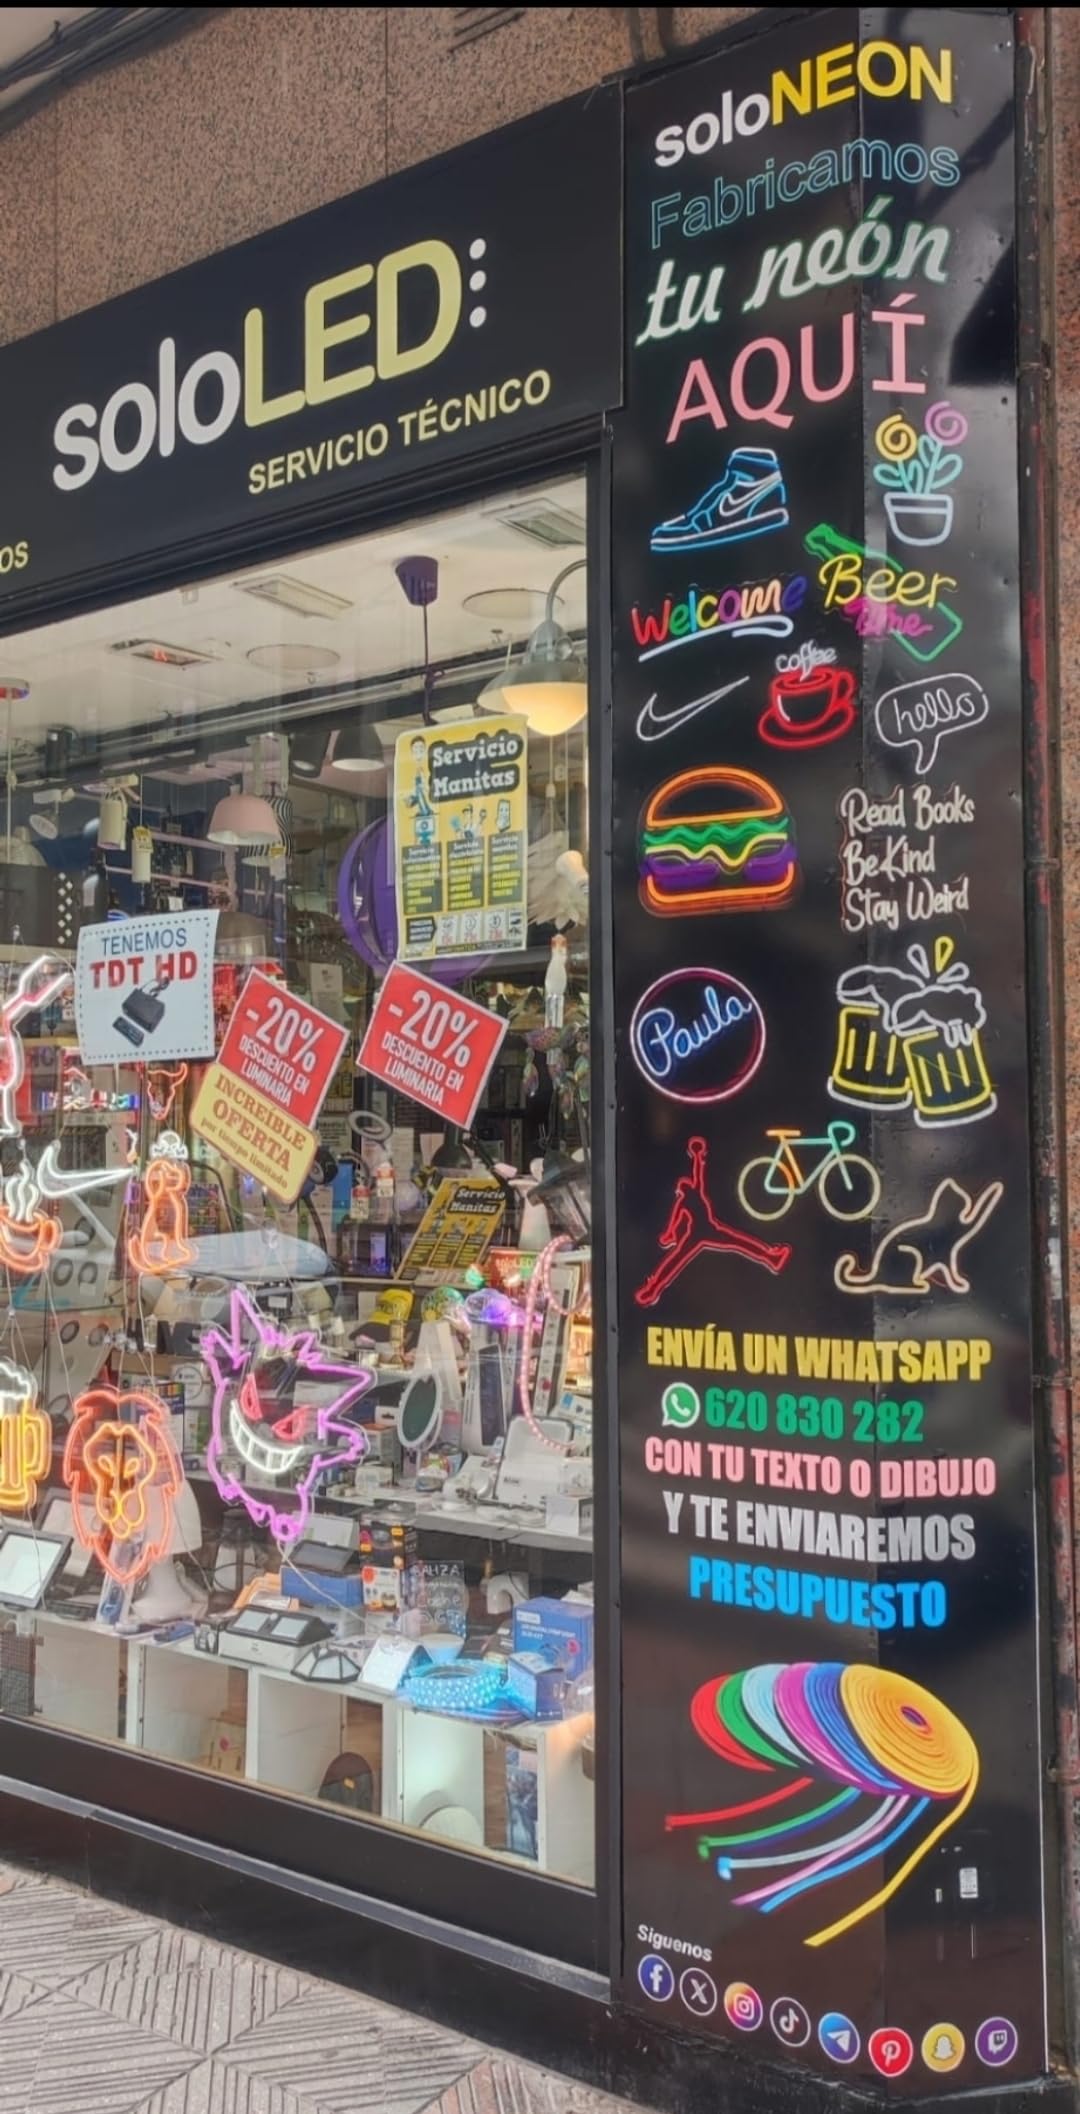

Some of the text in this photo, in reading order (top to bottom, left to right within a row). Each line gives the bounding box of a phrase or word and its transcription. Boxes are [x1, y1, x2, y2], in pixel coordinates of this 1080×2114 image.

[655, 40, 952, 168] soloNEON
[651, 138, 961, 249] Fabricamos
[635, 195, 950, 347] tu neón
[53, 239, 462, 491] soloLED
[666, 293, 926, 443] AQUÍ
[249, 369, 552, 494] SERVICIO TÉCNICO
[631, 575, 807, 646] Welcome
[818, 554, 956, 609] Beer
[894, 688, 975, 735] hello
[433, 735, 518, 768] Servicio
[433, 769, 515, 797] Manitas
[841, 784, 975, 833] Read Books
[843, 834, 936, 885] Be Kind
[844, 877, 970, 933] Stay Weird
[90, 950, 197, 989] TDT HD
[101, 927, 187, 956] TENEMOS
[382, 1031, 464, 1092] DESCUENTO EN
[637, 986, 752, 1076] Paula
[239, 1034, 310, 1095] DESCUENTO EN
[240, 1057, 293, 1107] LUMINARIA
[384, 1057, 445, 1107] LUMINARIA
[213, 1099, 291, 1172] OFERTA
[215, 1074, 307, 1151] INCREÍBLE
[201, 1117, 288, 1189] por tiempo limitado
[451, 1201, 498, 1214] Manitas
[457, 1187, 505, 1199] Servicio
[647, 1324, 992, 1382] ENVÍA UN WHATSAPP
[705, 1388, 924, 1443] 620 830 282
[645, 1437, 996, 1499] CON TU TEXTO O DIBUJO
[662, 1491, 976, 1562] Y TE ENVIAREMOS
[689, 1556, 946, 1629] PRESUPUESTO
